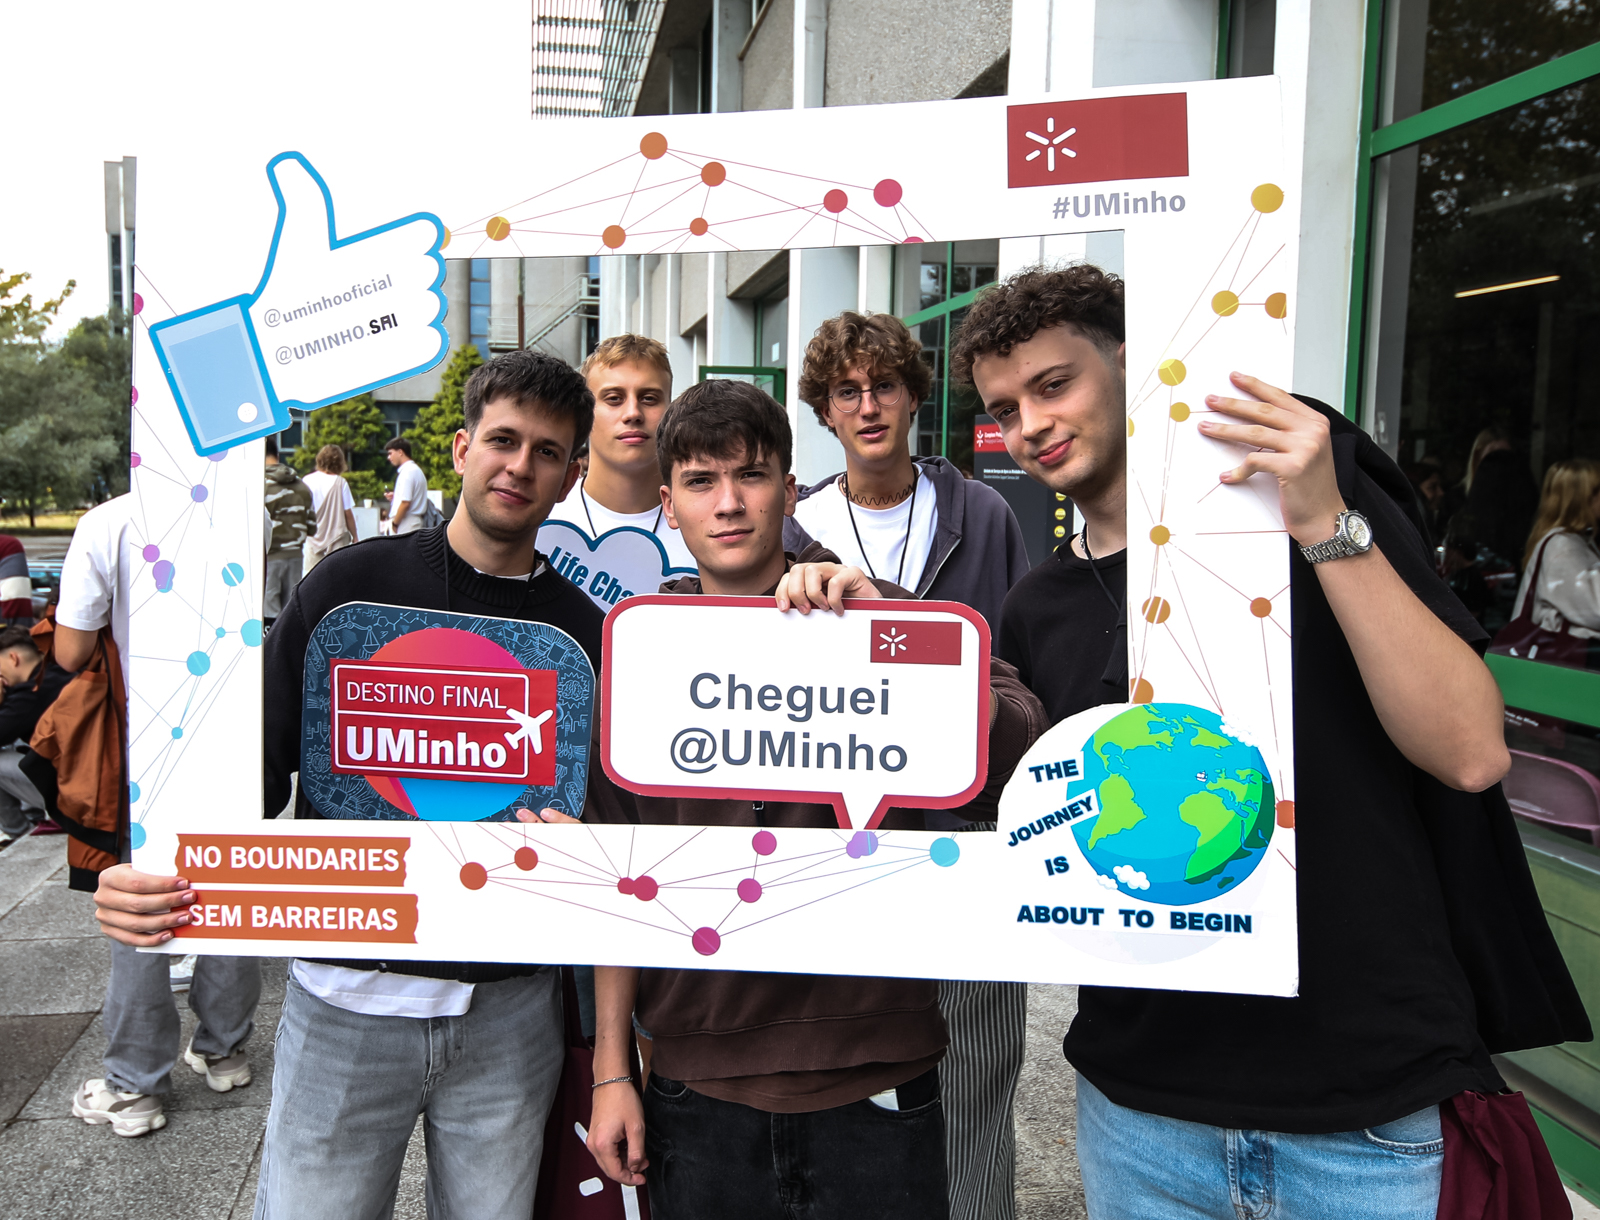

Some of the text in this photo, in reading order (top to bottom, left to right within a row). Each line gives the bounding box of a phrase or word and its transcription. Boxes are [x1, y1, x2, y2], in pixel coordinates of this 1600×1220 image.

[1052, 190, 1186, 219] #UMinho
[264, 274, 393, 327] @uminhooficial
[550, 546, 589, 587] Life
[346, 681, 507, 709] DESTINO FINAL
[689, 672, 889, 722] Cheguei
[346, 725, 507, 768] UMinho
[670, 727, 908, 774] @UMinho
[1028, 759, 1079, 783] THE
[1007, 796, 1094, 847] JOURNEY
[184, 845, 400, 872] NO BOUNDARIES
[1044, 856, 1070, 876] IS
[188, 904, 399, 931] SEM BARREIRAS
[1016, 905, 1253, 933] ABOUT TO BEGIN
